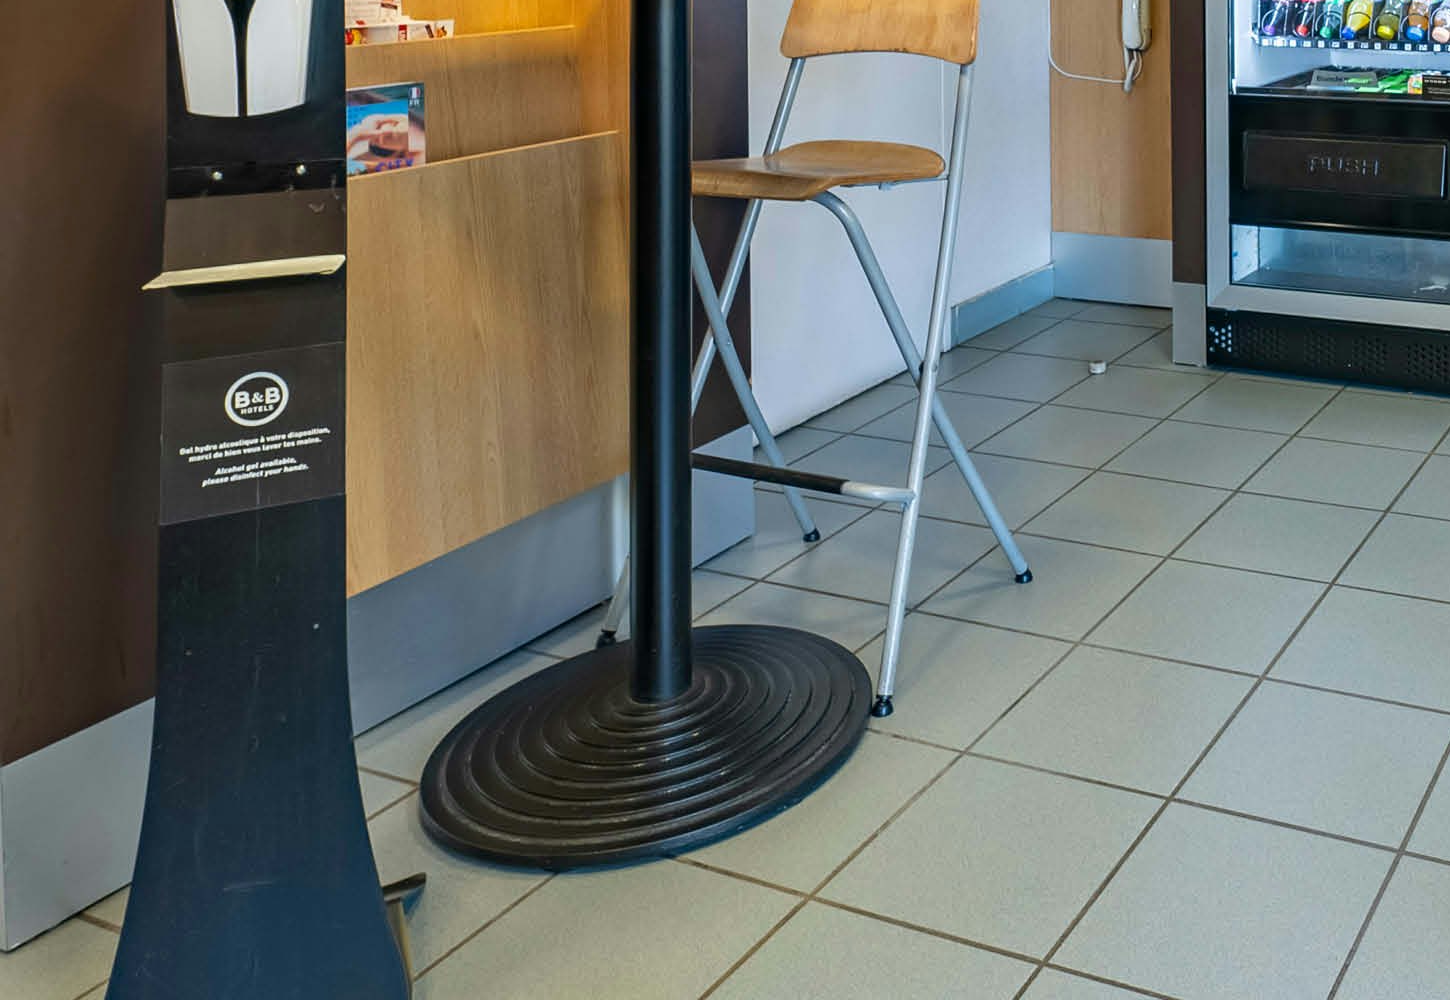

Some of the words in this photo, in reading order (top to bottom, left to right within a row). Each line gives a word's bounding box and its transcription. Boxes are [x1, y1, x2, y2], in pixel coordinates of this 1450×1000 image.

[1307, 156, 1380, 177] PUSH
[234, 386, 281, 409] B&B
[240, 404, 275, 415] HOTELS
[188, 453, 212, 463] merci
[213, 451, 223, 459] de
[224, 448, 242, 457] bien
[243, 446, 261, 454] vous
[262, 442, 282, 452] laver
[283, 440, 295, 448] les
[194, 444, 218, 455] hydro
[260, 435, 265, 443] à
[266, 432, 287, 443] votre
[201, 476, 229, 488] please
[230, 470, 264, 482] disinfect
[264, 467, 283, 478] your
[283, 463, 310, 473] hands.
[214, 464, 245, 476] Alcohol
[246, 462, 259, 471] gel
